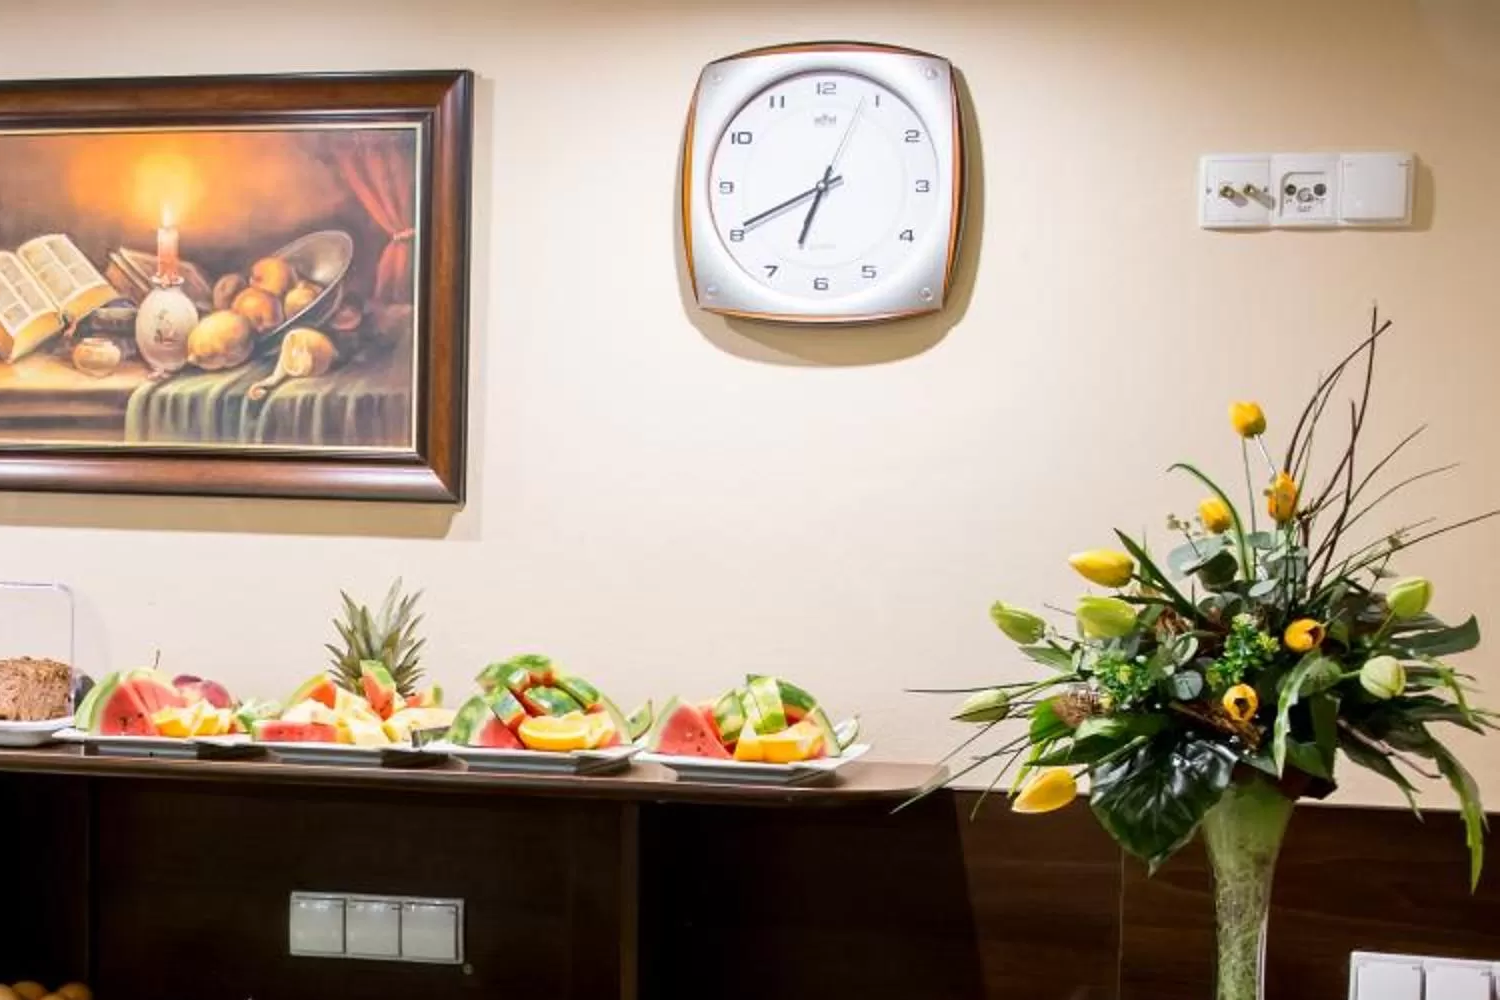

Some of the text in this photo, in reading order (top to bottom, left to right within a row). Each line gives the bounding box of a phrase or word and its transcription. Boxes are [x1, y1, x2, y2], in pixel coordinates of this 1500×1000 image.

[816, 82, 836, 95] 12
[769, 95, 785, 108] 11
[731, 131, 752, 144] 10
[905, 130, 920, 142] 2
[719, 182, 734, 194] 9
[916, 180, 929, 192] 3
[730, 230, 744, 242] 8
[900, 230, 914, 242] 4
[764, 265, 778, 277] 7
[862, 265, 876, 278] 5
[814, 278, 828, 290] 6
